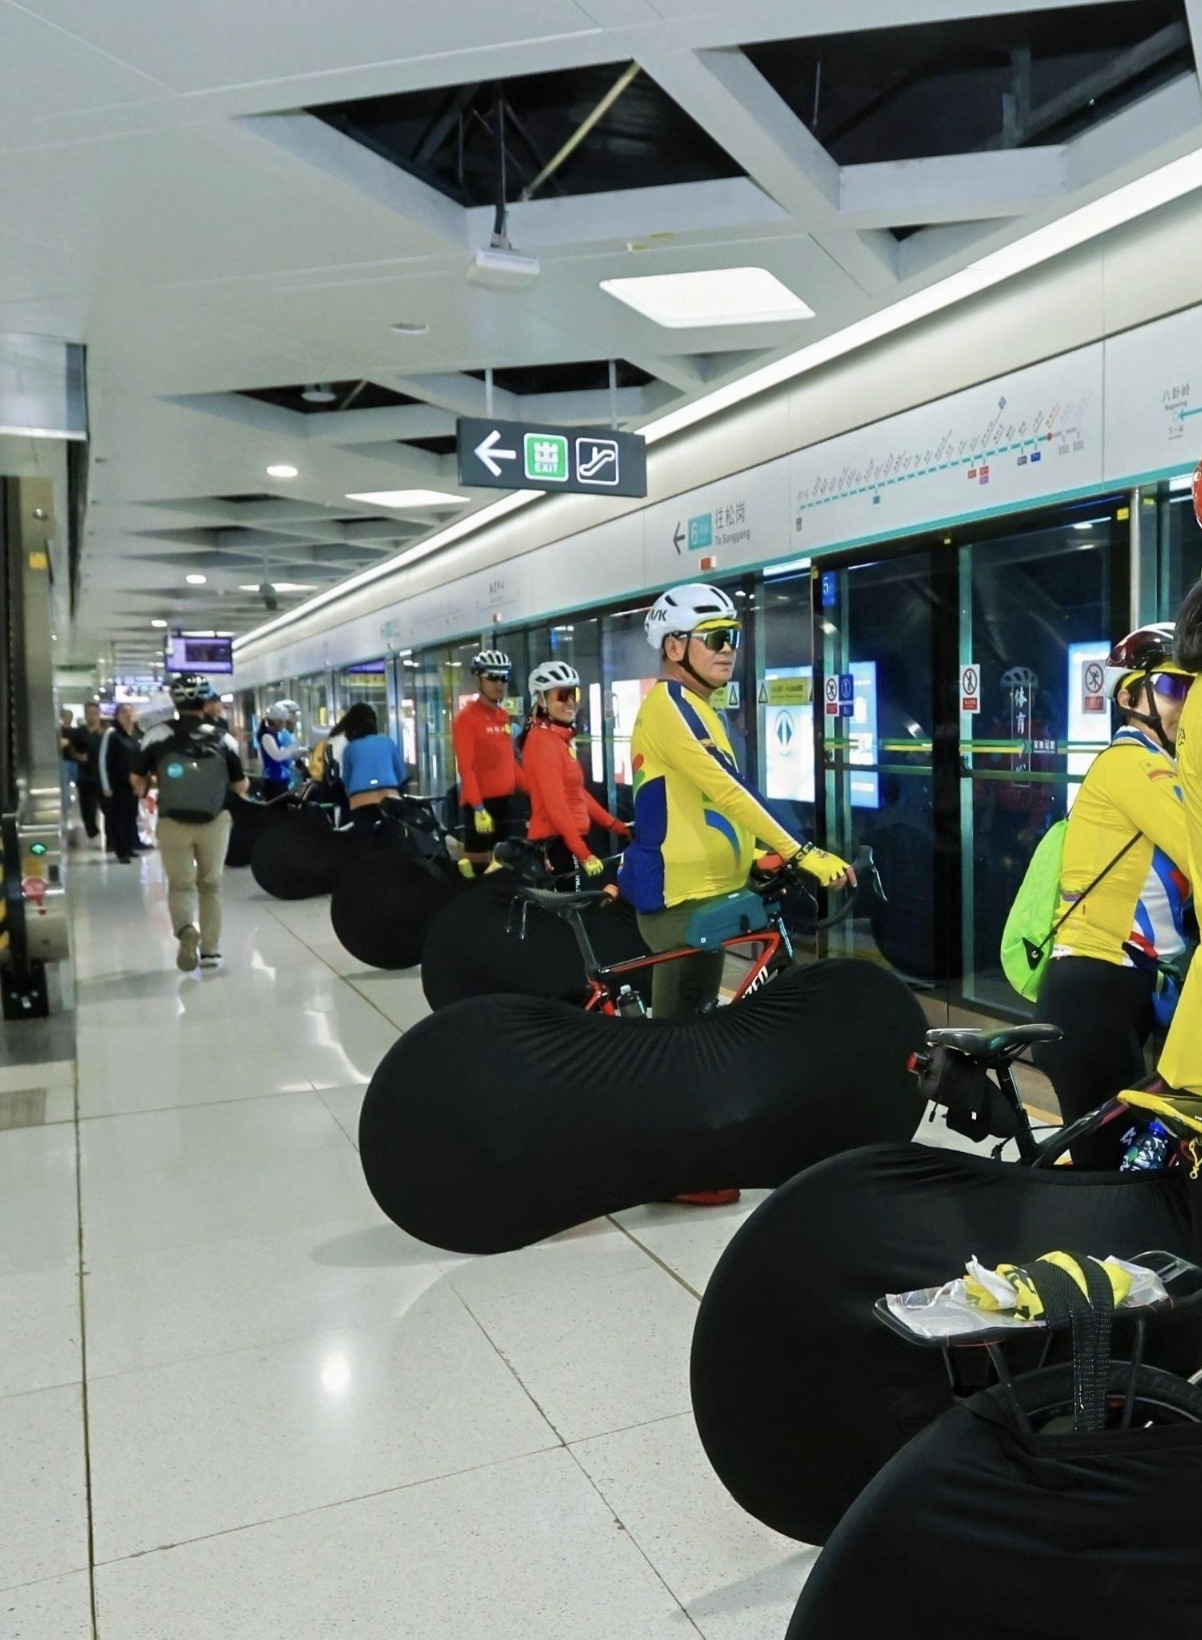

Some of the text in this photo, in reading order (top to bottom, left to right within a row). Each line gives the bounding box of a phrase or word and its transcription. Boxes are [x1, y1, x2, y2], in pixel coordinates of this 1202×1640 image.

[535, 462, 558, 473] EXIT
[715, 502, 746, 530] 往松岗
